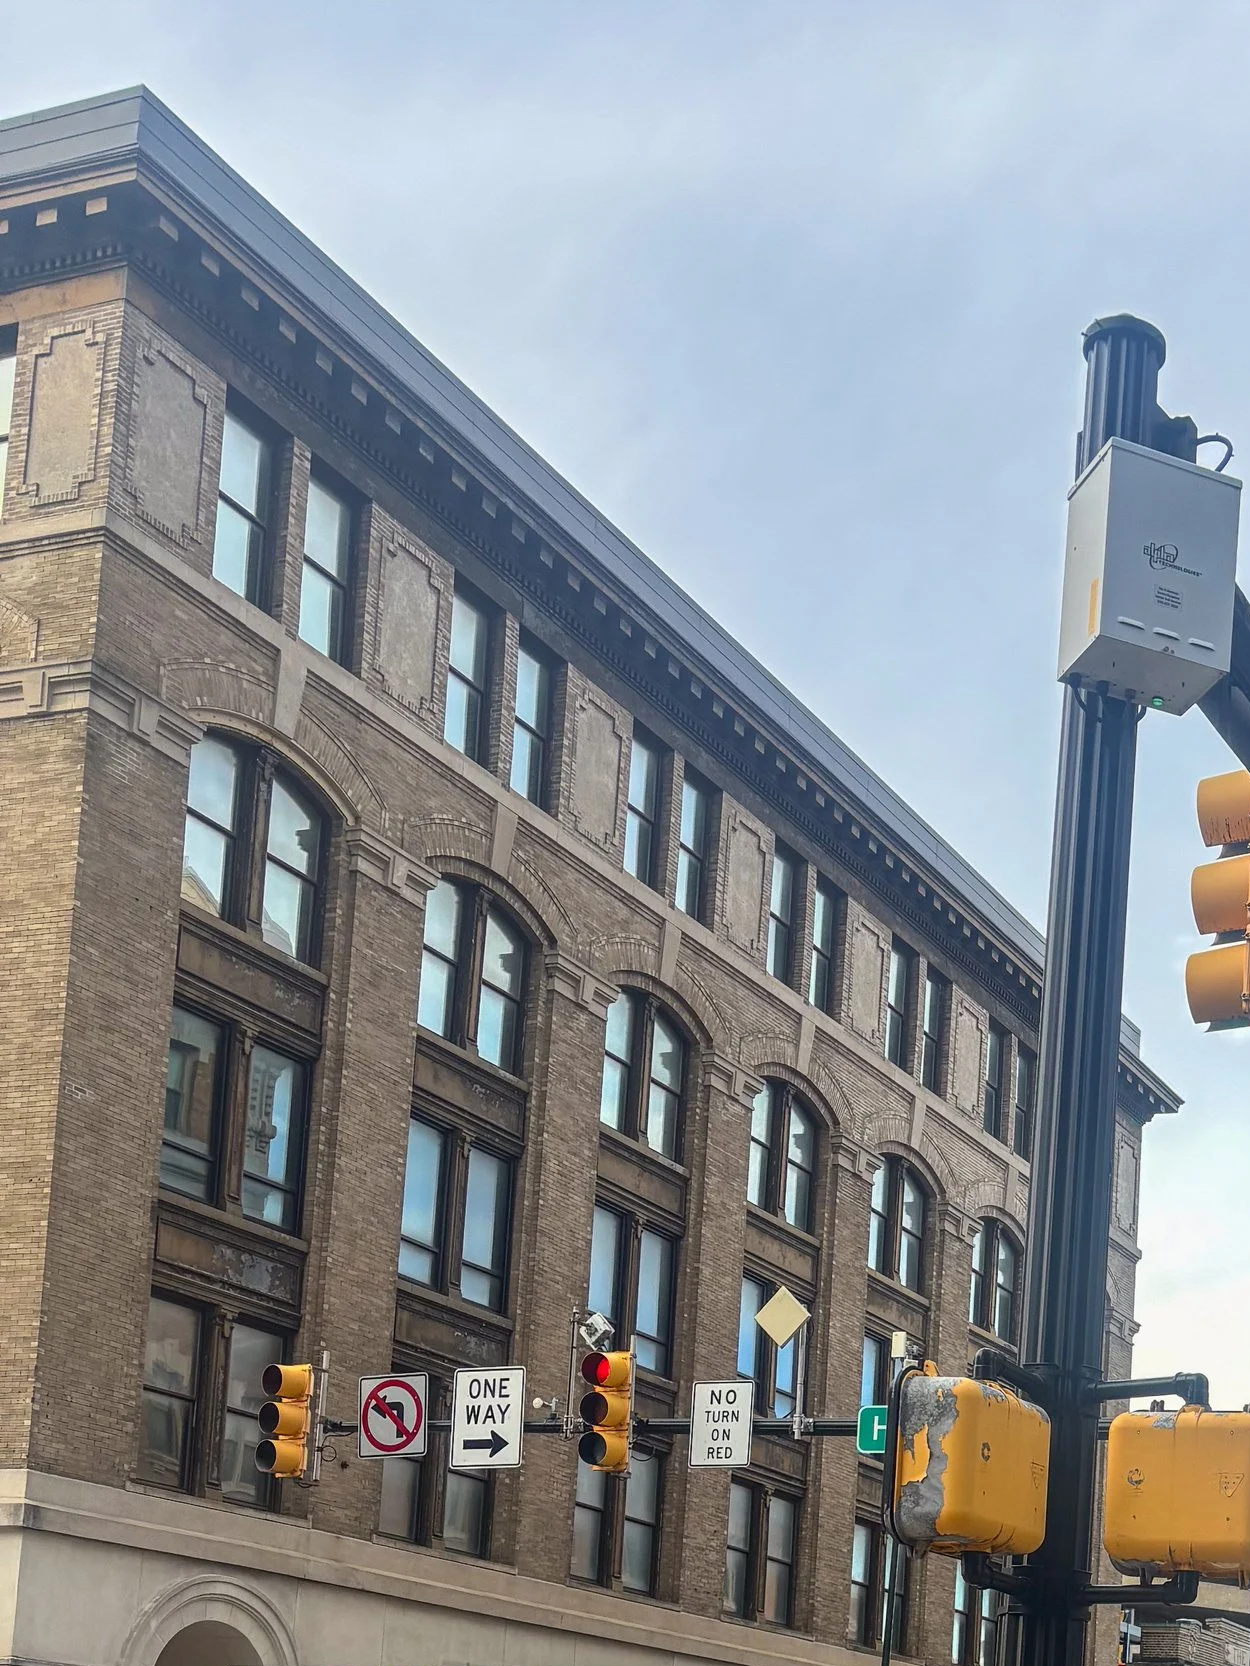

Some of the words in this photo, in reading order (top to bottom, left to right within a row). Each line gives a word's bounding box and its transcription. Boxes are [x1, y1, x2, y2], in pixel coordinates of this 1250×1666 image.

[468, 1378, 511, 1399] ONE
[710, 1389, 737, 1406] NO
[465, 1403, 511, 1425] WAY
[704, 1409, 740, 1425] TURN
[710, 1428, 732, 1443] ON
[706, 1446, 733, 1461] RED
